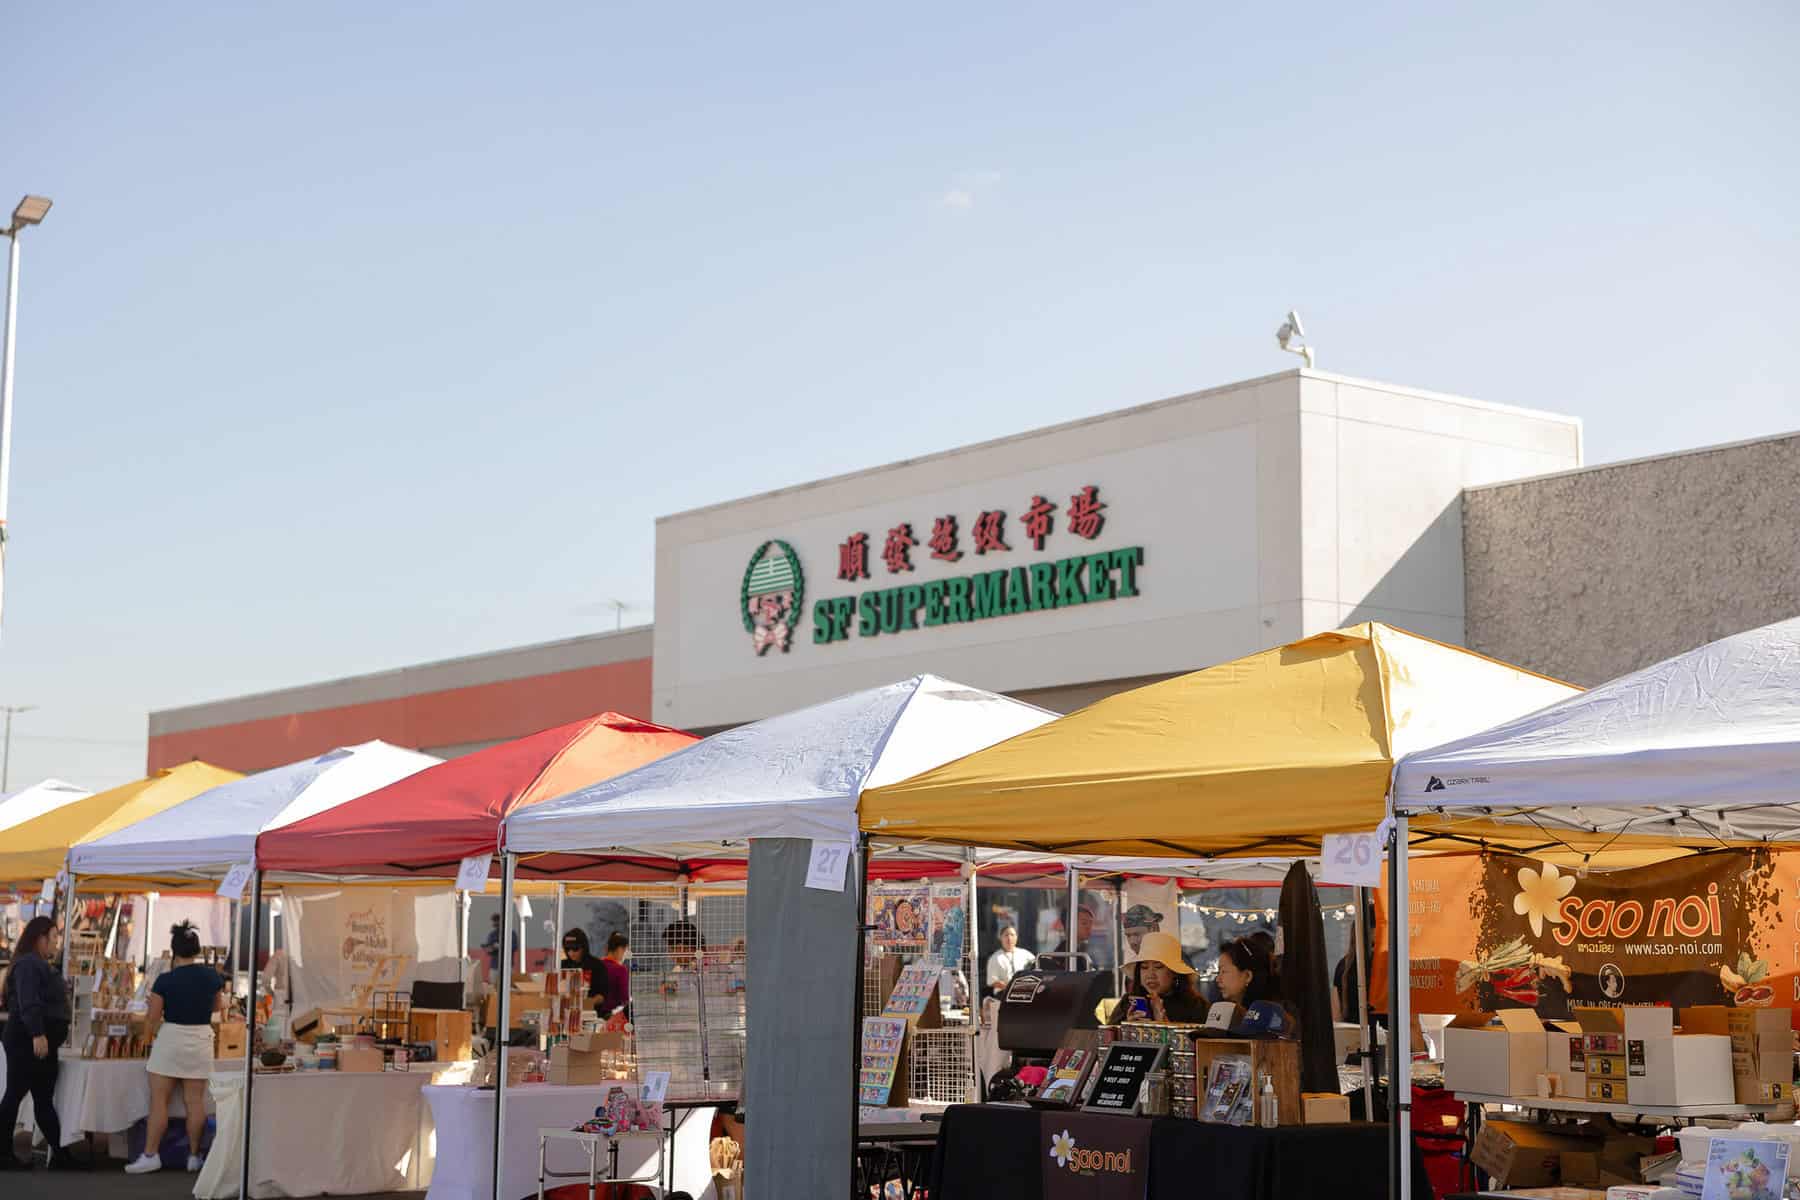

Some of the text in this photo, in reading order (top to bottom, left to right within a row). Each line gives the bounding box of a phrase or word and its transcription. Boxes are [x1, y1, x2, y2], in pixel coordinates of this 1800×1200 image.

[813, 546, 1143, 644] SF SUPERMARKET
[817, 848, 840, 873] 27
[1335, 835, 1370, 865] 26
[1552, 882, 1721, 946] sao noi
[1624, 941, 1723, 955] www.sao-noi.com
[1069, 1147, 1103, 1173] sao
